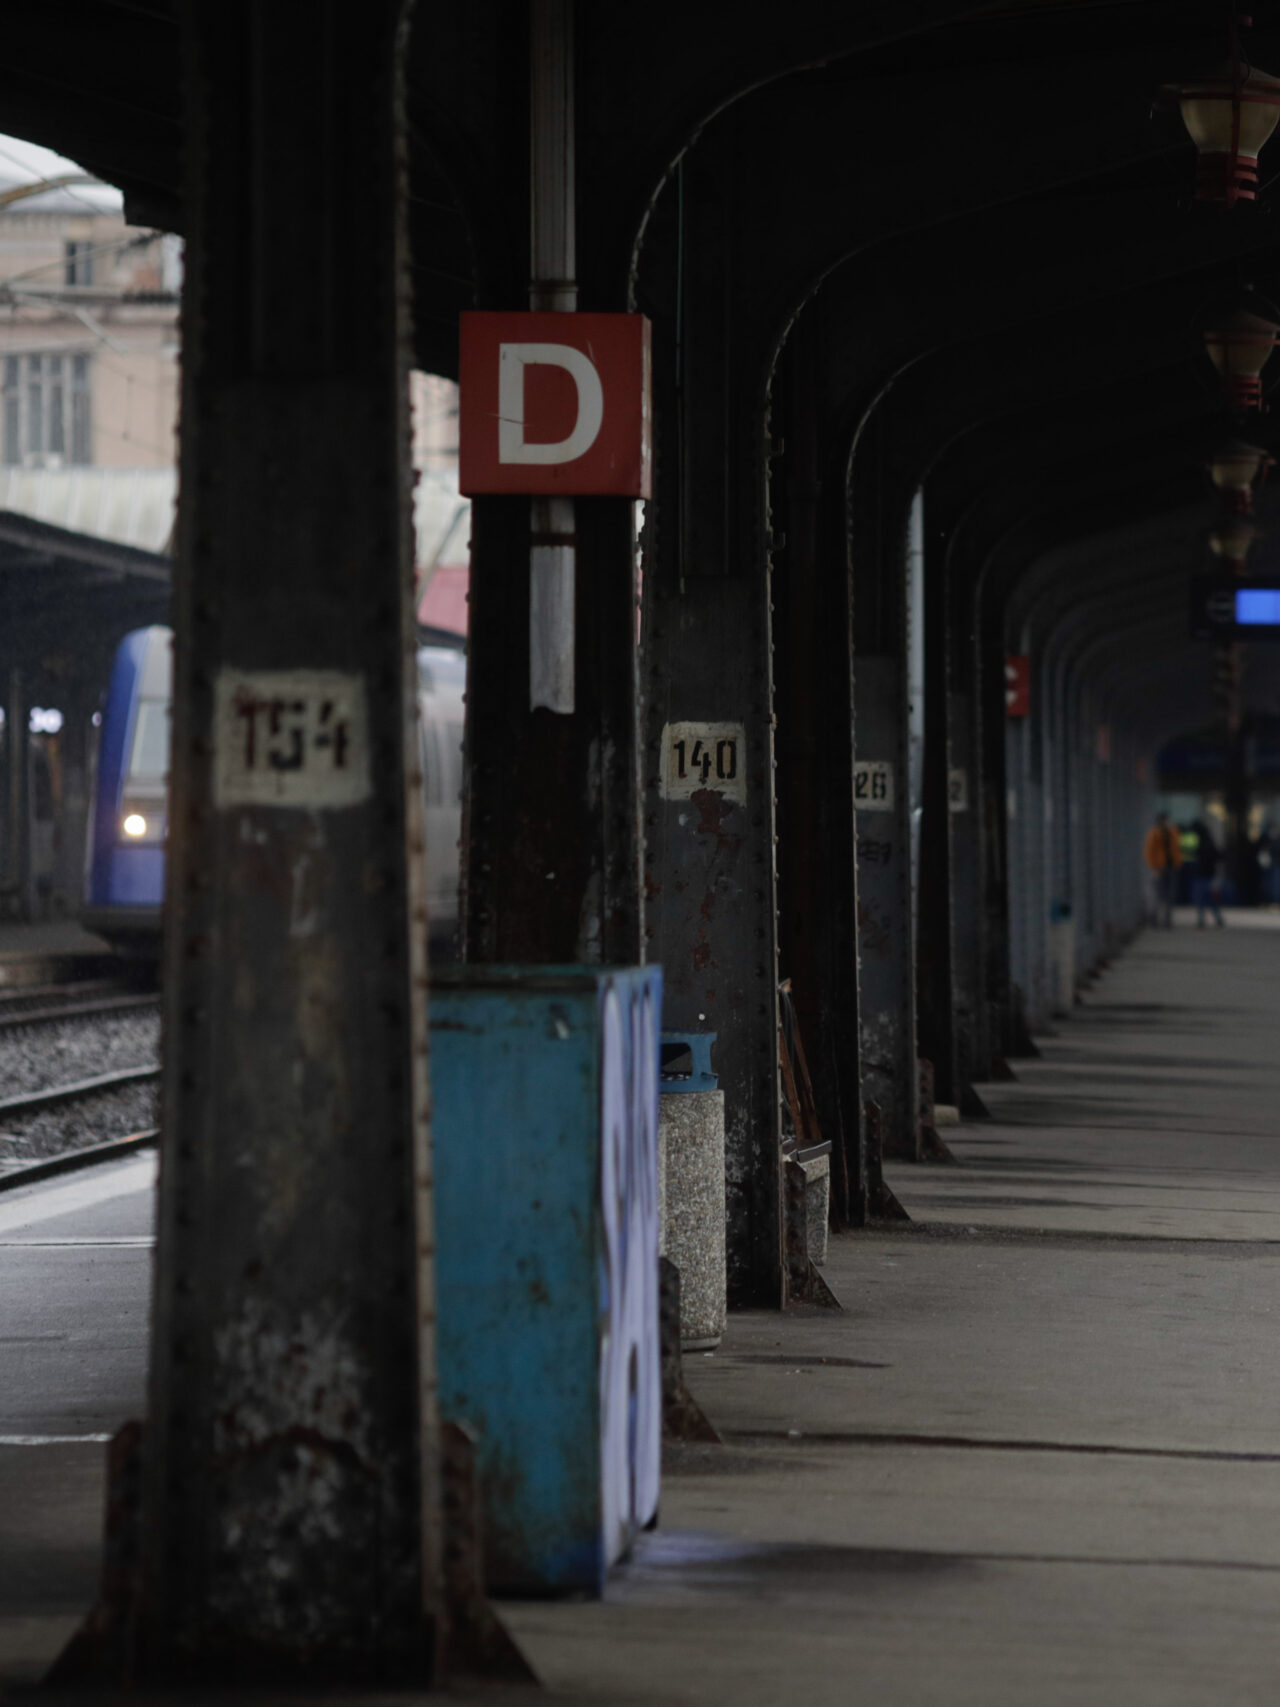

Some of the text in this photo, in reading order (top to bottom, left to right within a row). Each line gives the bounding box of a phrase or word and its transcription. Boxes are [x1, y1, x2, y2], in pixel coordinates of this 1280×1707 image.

[498, 342, 605, 465] D
[235, 694, 349, 770] 154
[674, 740, 737, 780] 140
